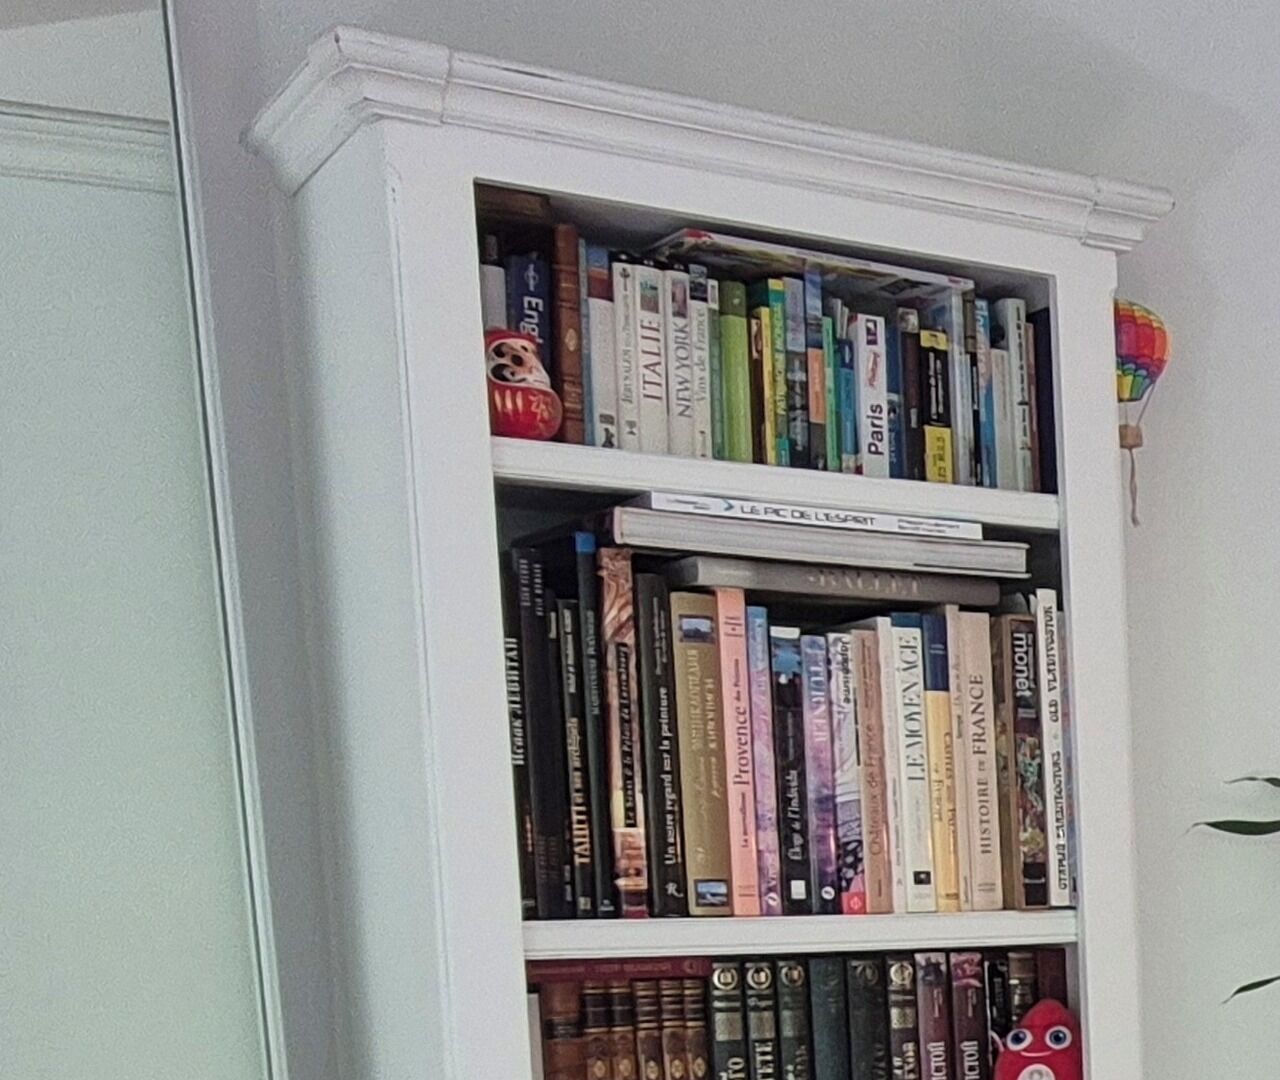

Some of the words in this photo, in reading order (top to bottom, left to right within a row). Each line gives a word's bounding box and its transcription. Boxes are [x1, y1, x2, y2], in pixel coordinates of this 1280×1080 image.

[672, 322, 690, 370] YORK
[694, 308, 706, 351] France
[640, 320, 663, 401] ITALIE
[695, 356, 705, 372] de
[674, 371, 692, 418] NEW
[695, 376, 706, 402] Vins
[867, 404, 884, 456] Paris
[740, 504, 761, 516] LE
[763, 506, 787, 519] PIC
[790, 509, 812, 521] DE
[897, 635, 920, 673] ÂGE
[1015, 633, 1030, 696] monet
[1043, 605, 1058, 692] VLADIVOSTOK
[505, 637, 523, 714] ЛЕВИТАН
[656, 687, 673, 736] peinture
[902, 680, 924, 751] MOYEN
[968, 674, 986, 756] FRANCE
[1048, 699, 1059, 723] OLD
[509, 717, 525, 766] Исаак
[732, 706, 751, 786] Provence
[863, 724, 878, 768] France
[867, 773, 879, 788] de
[906, 753, 925, 781] LE
[660, 773, 676, 810] regard
[571, 805, 592, 866] TAHITI
[868, 795, 882, 856] Châteaux
[977, 779, 992, 854] HISTOIRE
[662, 842, 677, 864] Un
